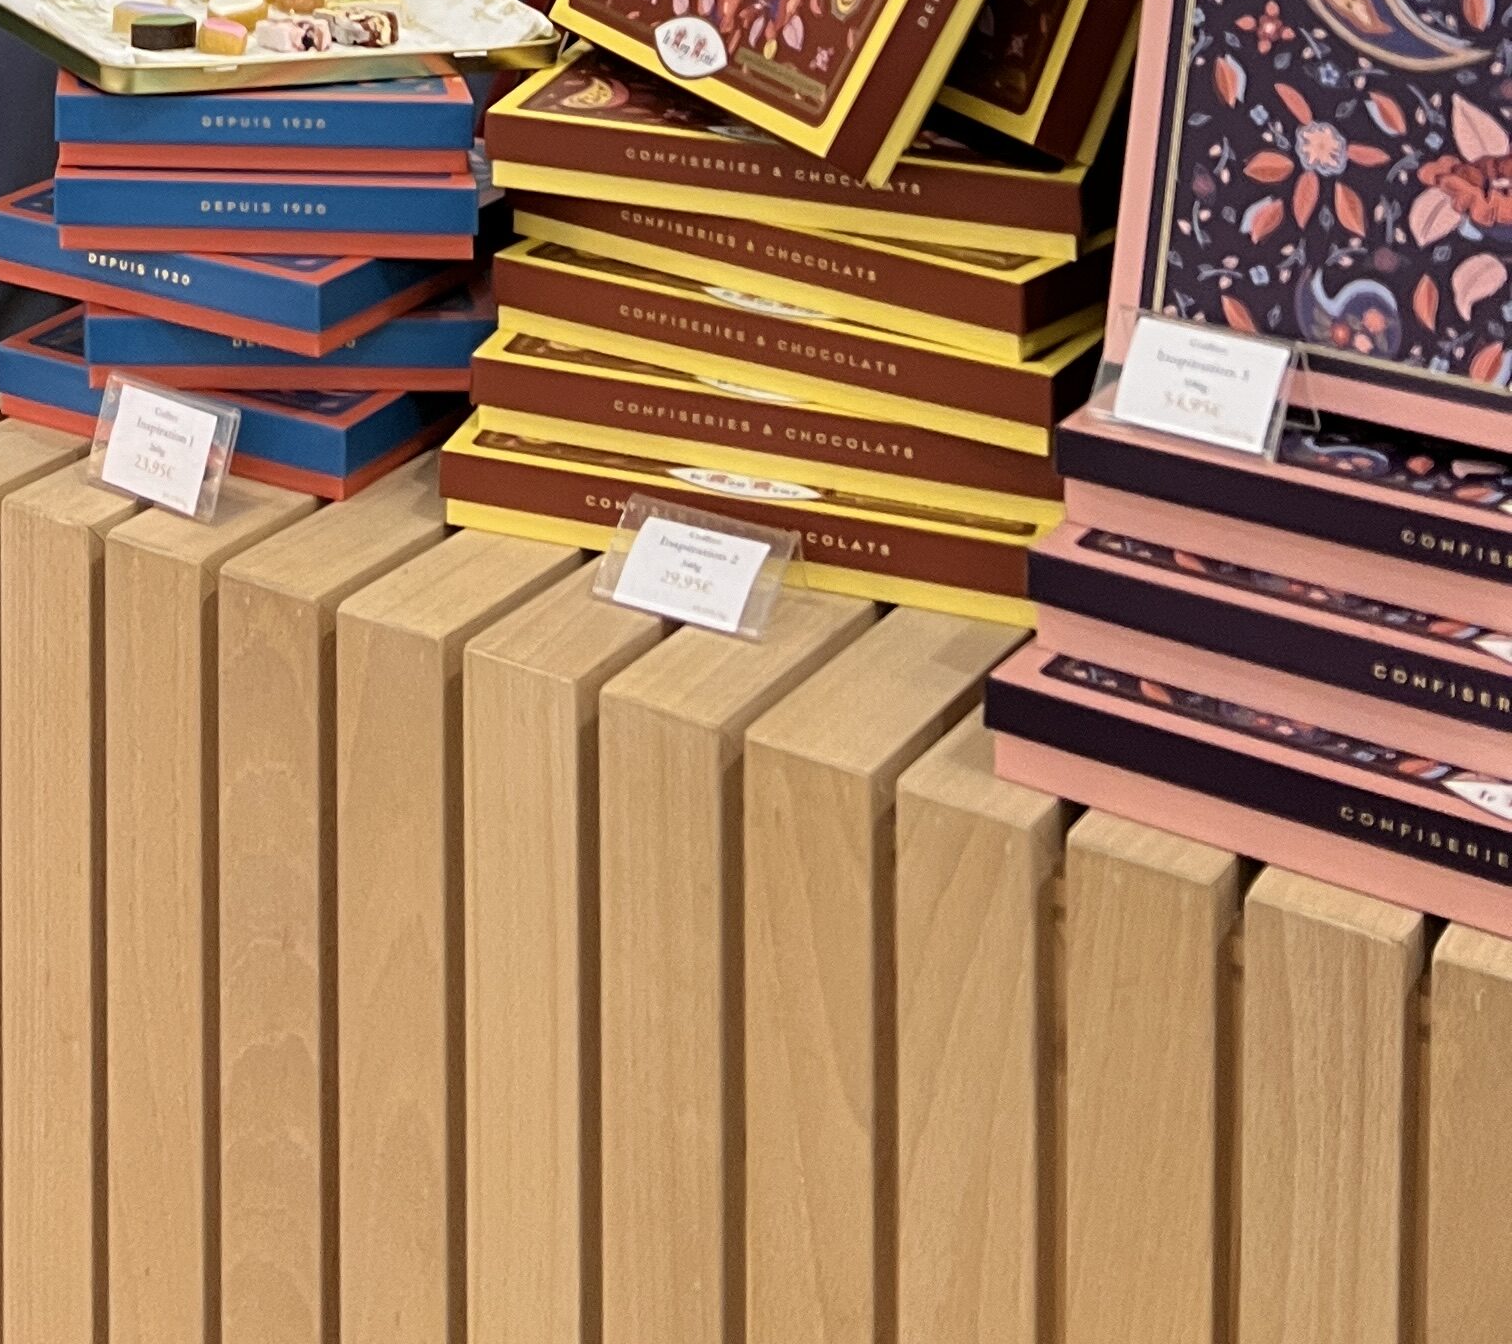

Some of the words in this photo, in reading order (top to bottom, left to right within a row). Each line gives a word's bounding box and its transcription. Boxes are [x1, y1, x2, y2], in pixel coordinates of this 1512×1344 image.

[201, 115, 271, 129] DEPUIS
[282, 117, 326, 130] 1920
[625, 147, 760, 176] CONFISERIES
[772, 166, 782, 178] &
[200, 200, 271, 214] DEPUIS
[283, 202, 327, 215] 1920
[620, 210, 737, 248] CONFISERIES
[746, 239, 755, 253] &
[765, 244, 877, 282] CHOCOLATS
[88, 252, 145, 276] DEPUIS
[154, 267, 191, 286] 1920
[619, 304, 746, 343] CONFISERIES
[756, 335, 766, 347] &
[777, 339, 898, 376] CHOCOLATS
[613, 399, 751, 432] CONFISERIES
[762, 423, 773, 436] &
[785, 427, 914, 460] CHOCOLATS
